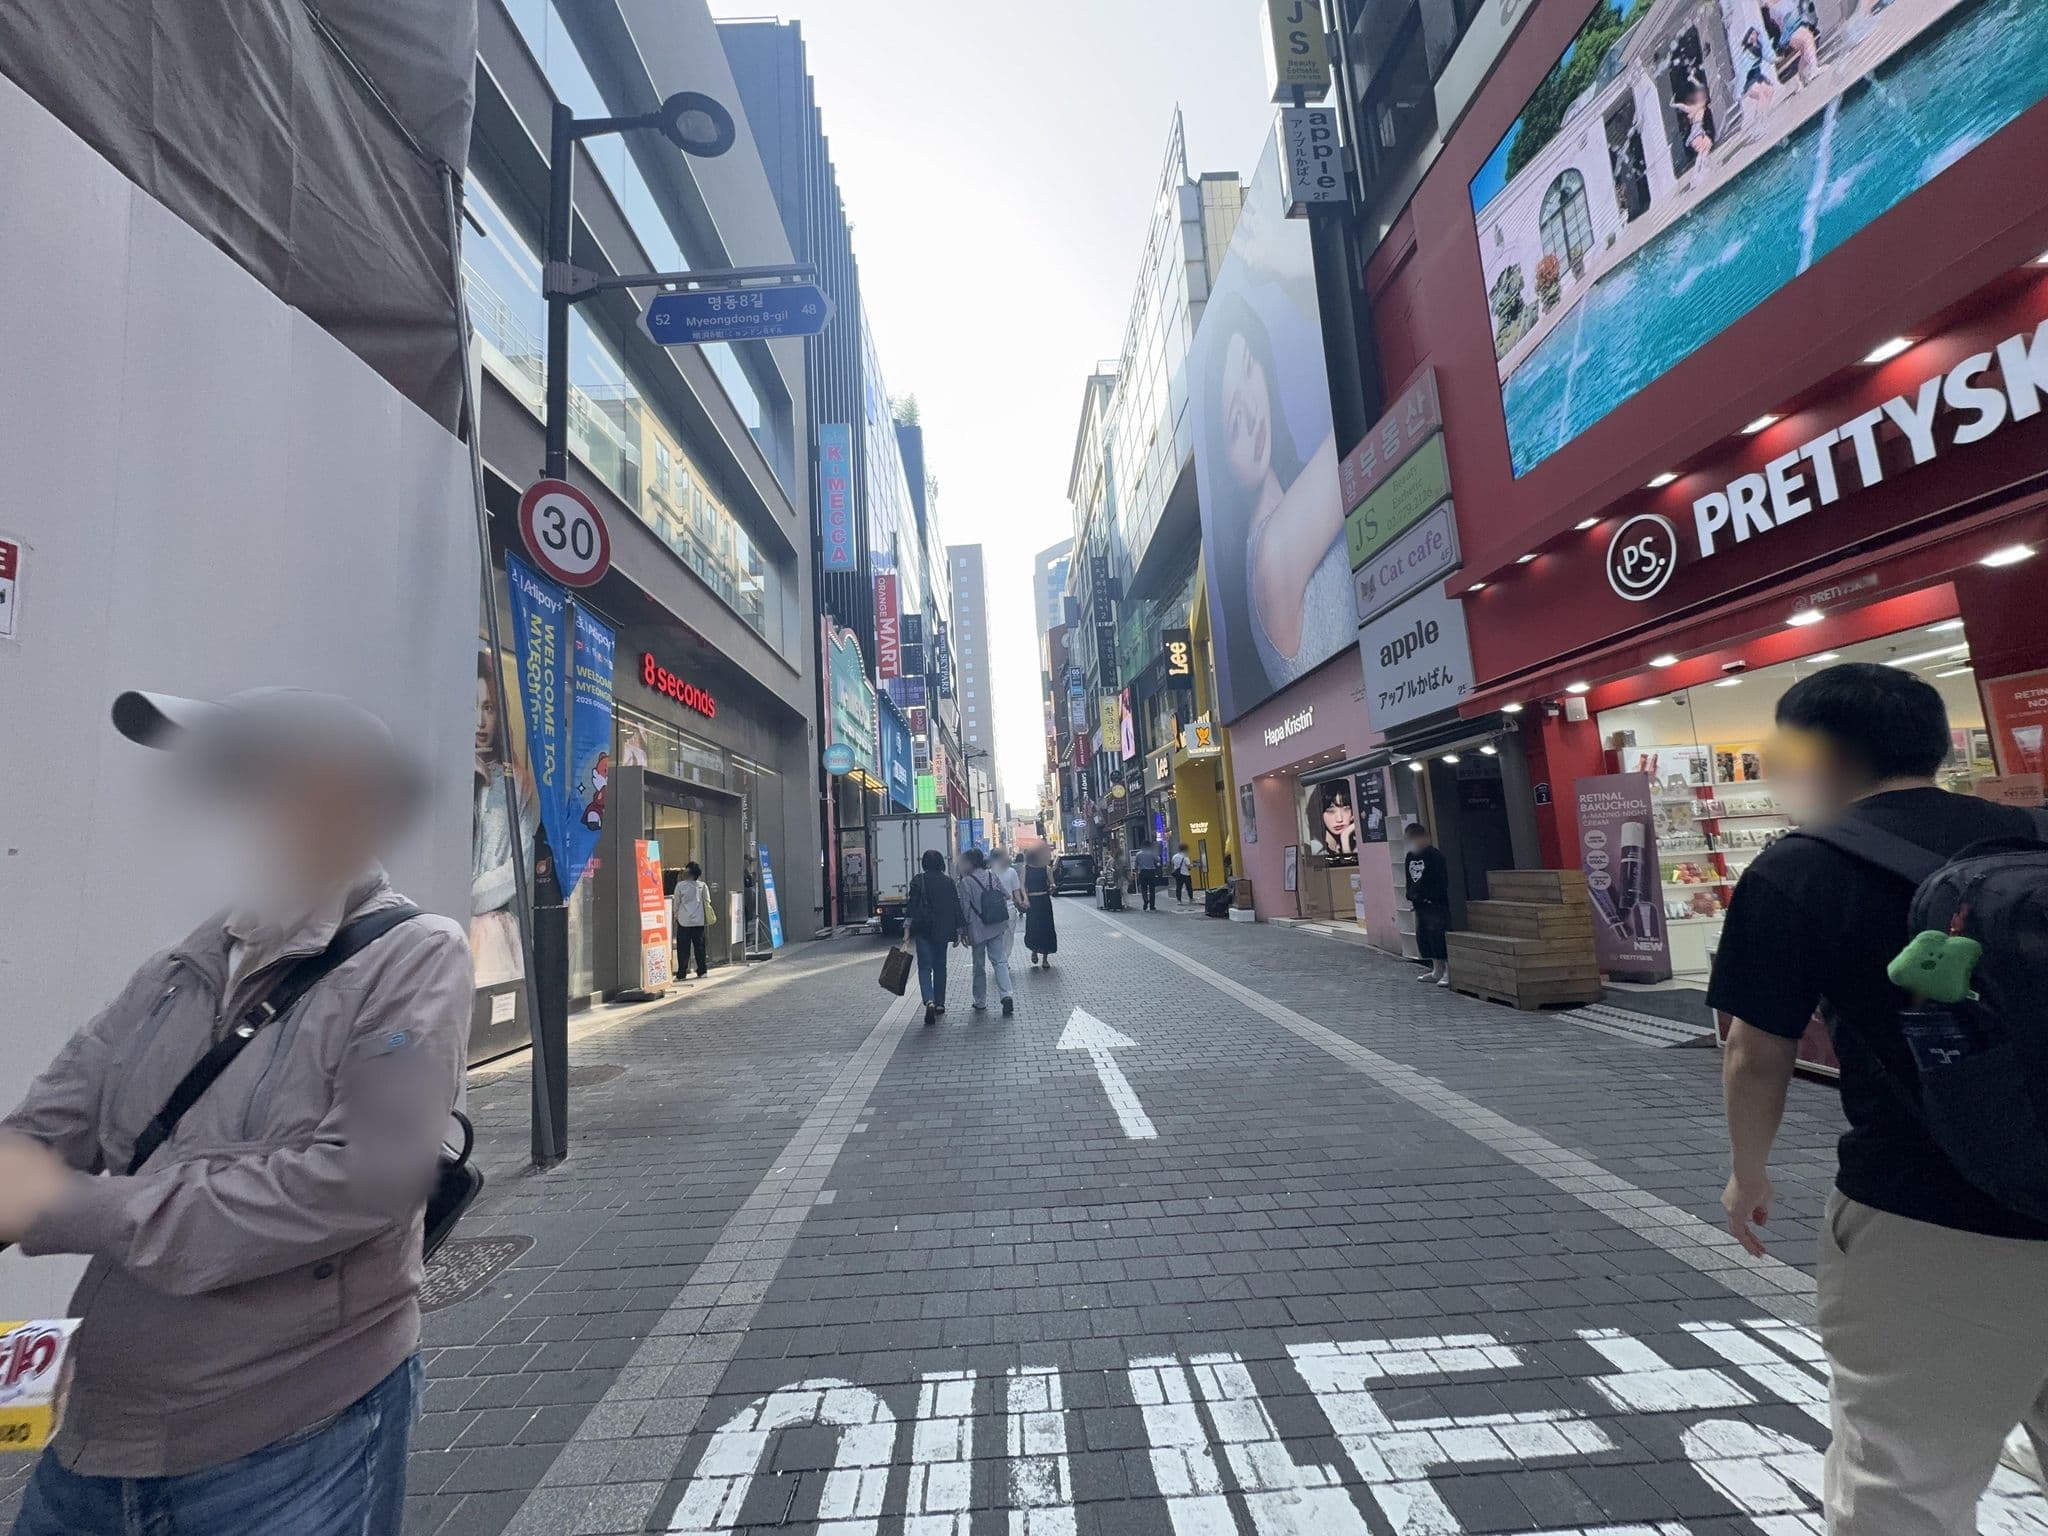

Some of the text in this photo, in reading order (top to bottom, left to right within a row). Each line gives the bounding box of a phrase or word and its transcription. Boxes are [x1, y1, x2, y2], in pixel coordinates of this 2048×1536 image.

[1309, 113, 1336, 188] apple
[1313, 192, 1329, 200] 2F
[707, 293, 764, 311] 명동8길
[801, 304, 817, 315] 48
[655, 314, 671, 326] 52
[686, 311, 788, 328] Myeongdong 8-gil
[542, 505, 594, 560] 30
[1355, 506, 1378, 551] JS
[1379, 530, 1442, 587] Cat cafe
[878, 577, 898, 675] ORANGE MART
[1380, 619, 1440, 668] apple
[1168, 641, 1189, 676] Lee
[544, 624, 555, 738] WELCOME
[643, 652, 657, 687] 8
[657, 666, 718, 719] seconds
[1379, 665, 1454, 710] アップルかばん
[1264, 725, 1287, 747] Hapa
[1155, 757, 1169, 780] Lee
[1579, 791, 1625, 803] RETINAL
[1580, 800, 1647, 812] BAKUCHIOL
[1622, 809, 1648, 817] NIGHT
[1633, 941, 1663, 951] NEW
